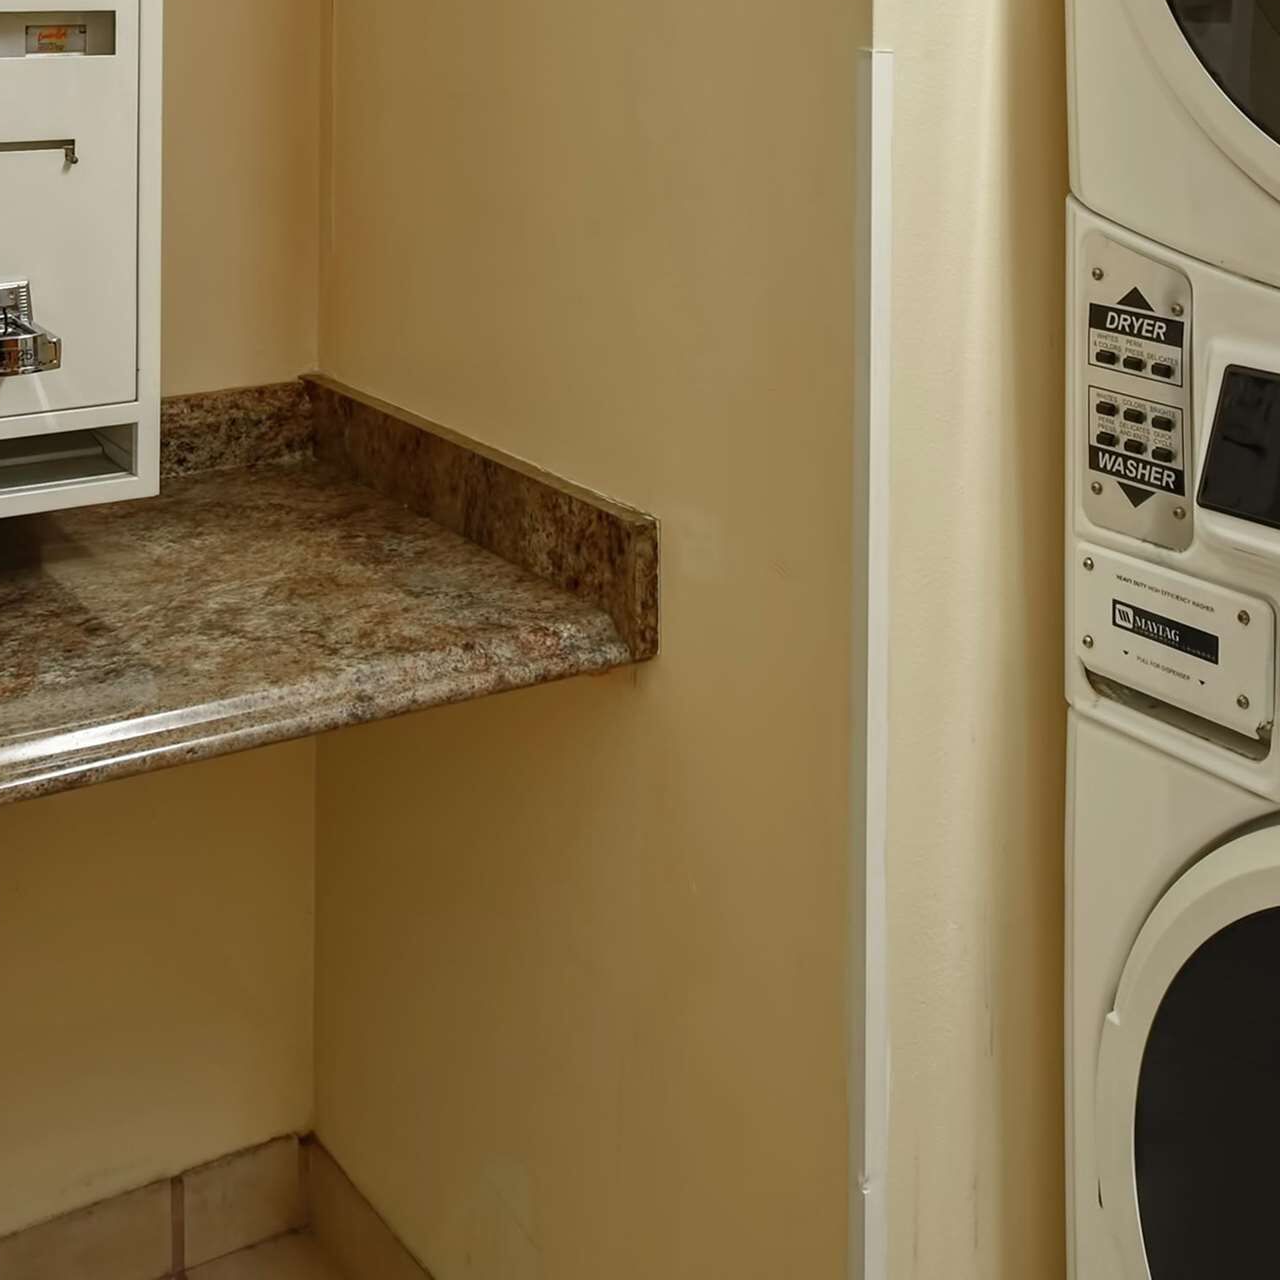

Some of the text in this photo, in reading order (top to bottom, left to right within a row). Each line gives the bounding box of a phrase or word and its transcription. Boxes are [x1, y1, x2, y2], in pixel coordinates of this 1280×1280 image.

[1106, 311, 1167, 341] DRYER
[1122, 399, 1147, 410] COLORS
[1098, 451, 1176, 489] WASHER
[1134, 615, 1180, 642] MAYTAG
